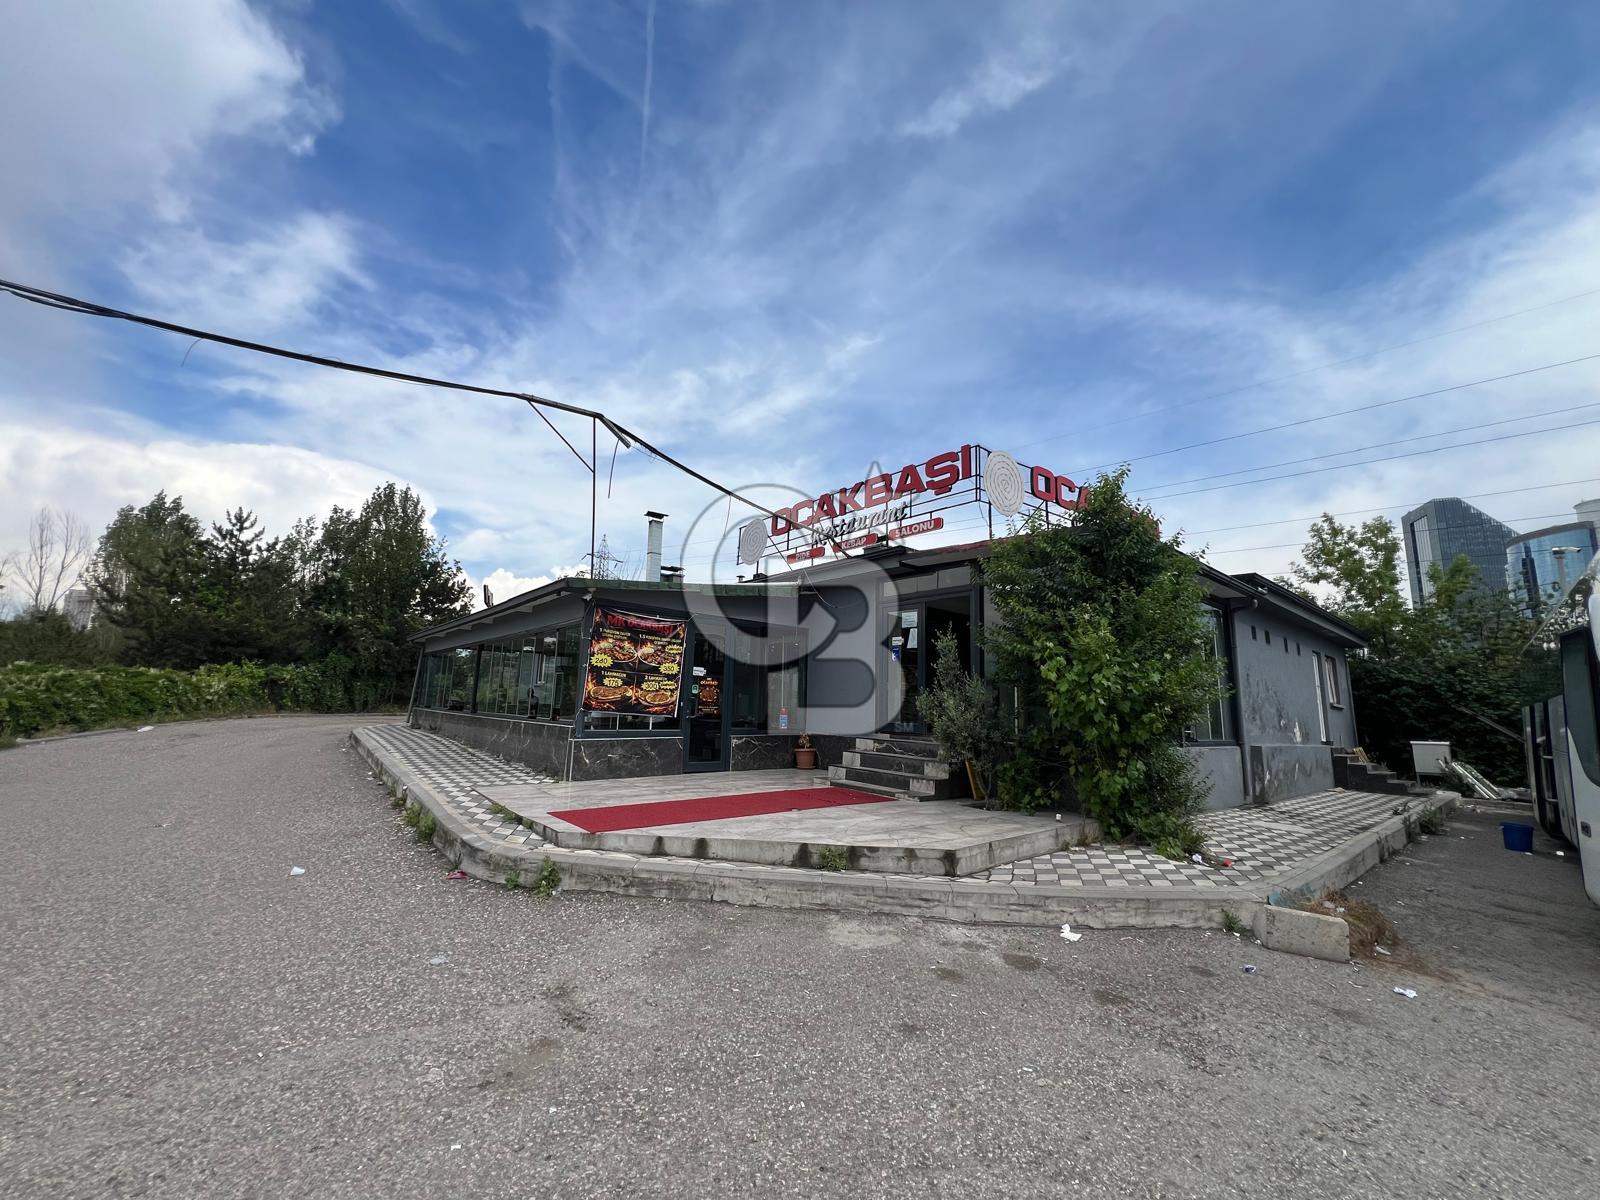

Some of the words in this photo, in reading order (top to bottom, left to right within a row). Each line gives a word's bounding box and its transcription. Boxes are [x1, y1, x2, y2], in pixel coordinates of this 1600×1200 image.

[770, 444, 972, 537] OCAKBAŞI
[841, 536, 867, 549] KEBAP
[895, 519, 935, 538] SALONU
